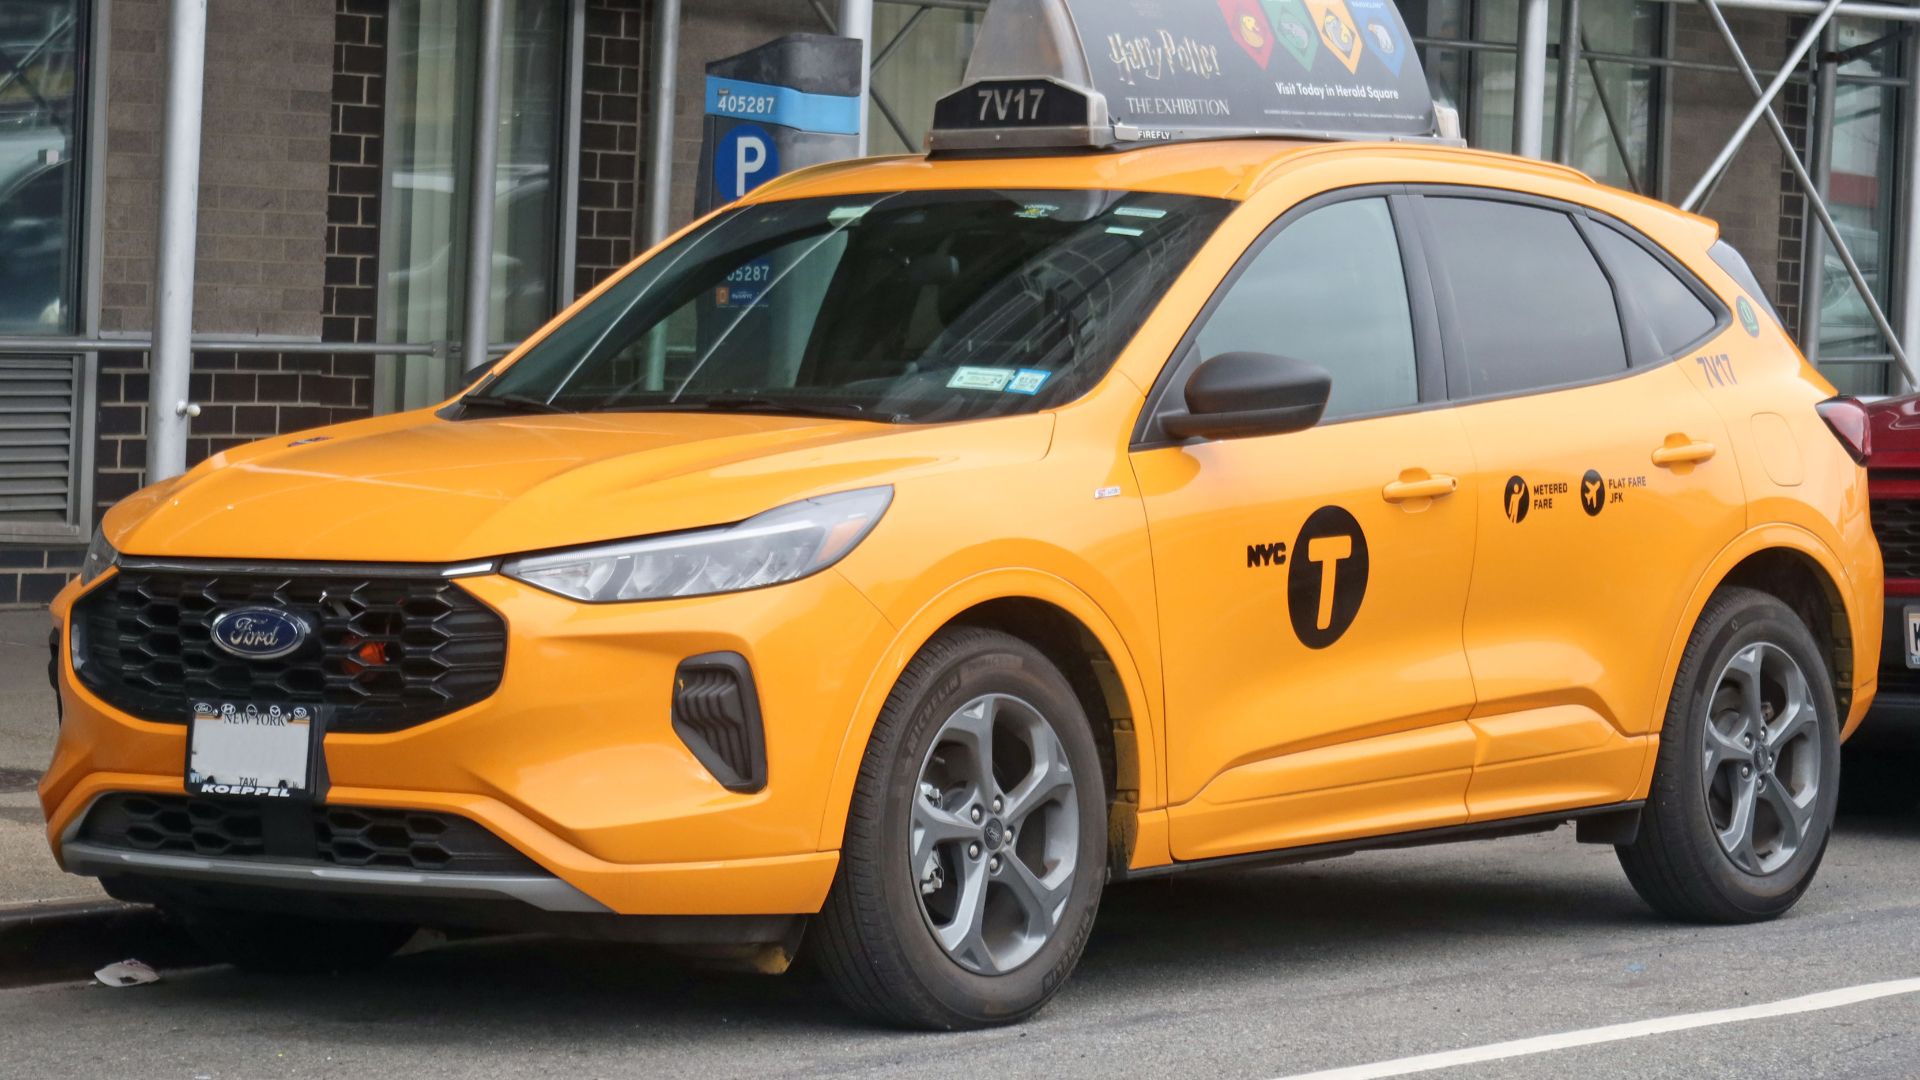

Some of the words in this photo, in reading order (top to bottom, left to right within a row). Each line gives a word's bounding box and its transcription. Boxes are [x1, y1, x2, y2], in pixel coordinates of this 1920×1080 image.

[1107, 32, 1162, 85] Harry
[1155, 28, 1221, 80] Potter
[1275, 82, 1296, 95] Visit
[1298, 83, 1325, 99] Today
[1326, 84, 1335, 96] in
[1335, 85, 1366, 99] Herald
[1366, 86, 1399, 102] Square
[718, 95, 775, 114] 405287
[978, 88, 1045, 121] 7V17
[1125, 97, 1154, 114] THE
[1155, 97, 1230, 115] EXHIBITION
[1137, 130, 1171, 140] FIREFLY
[736, 136, 767, 197] P
[1696, 354, 1738, 388] 7V17
[1533, 483, 1568, 496] METERED
[1608, 478, 1626, 490] FLAT
[1627, 476, 1647, 488] FARE
[1533, 498, 1553, 510] FARE
[1609, 492, 1624, 504] JFK
[1247, 542, 1286, 568] NYC
[1308, 535, 1352, 630] T
[229, 617, 279, 646] Ford
[224, 712, 250, 725] NEW
[255, 712, 287, 727] YORK
[201, 784, 290, 798] KOEPPEL
[239, 777, 258, 787] TAXI
